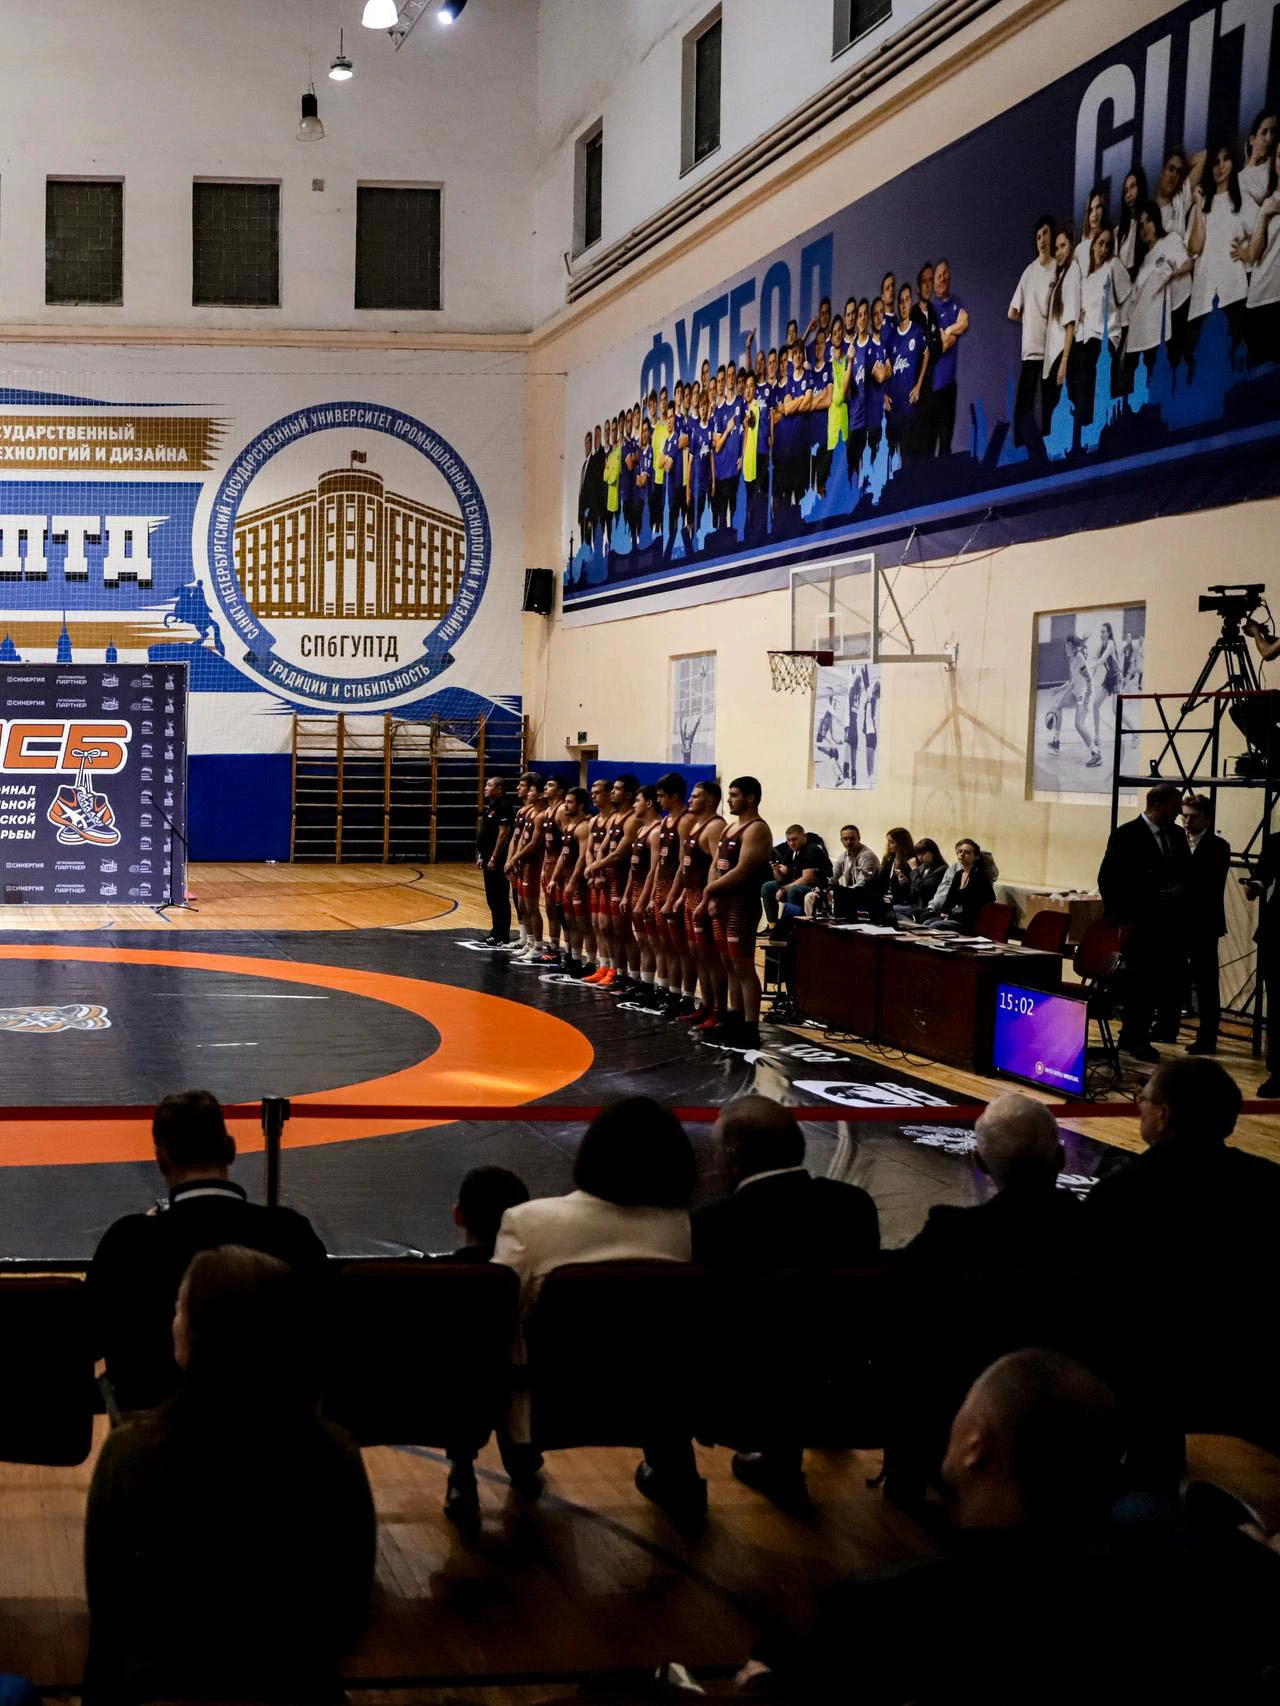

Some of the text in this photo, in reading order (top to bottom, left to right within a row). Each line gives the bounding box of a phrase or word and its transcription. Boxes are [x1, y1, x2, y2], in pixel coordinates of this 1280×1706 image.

[95, 447, 106, 461] И
[109, 444, 188, 464] ДИЗАЙНА
[214, 408, 485, 641] САНКТ-ПЕТЕРБУРГСКИЙ ГОСУДАРСТВЕННЫЙ УНИВЕРСИТЕТ ПРОМЫШЛЕННЫХ ТЕХНОЛОГИЙ И ДИЗАЙНА
[300, 634, 399, 662] СПбГУПТД
[268, 660, 431, 698] ТРАДИЦИИ И СТАБИЛЬНОСТЬ
[1000, 992, 1034, 1016] 15:02
